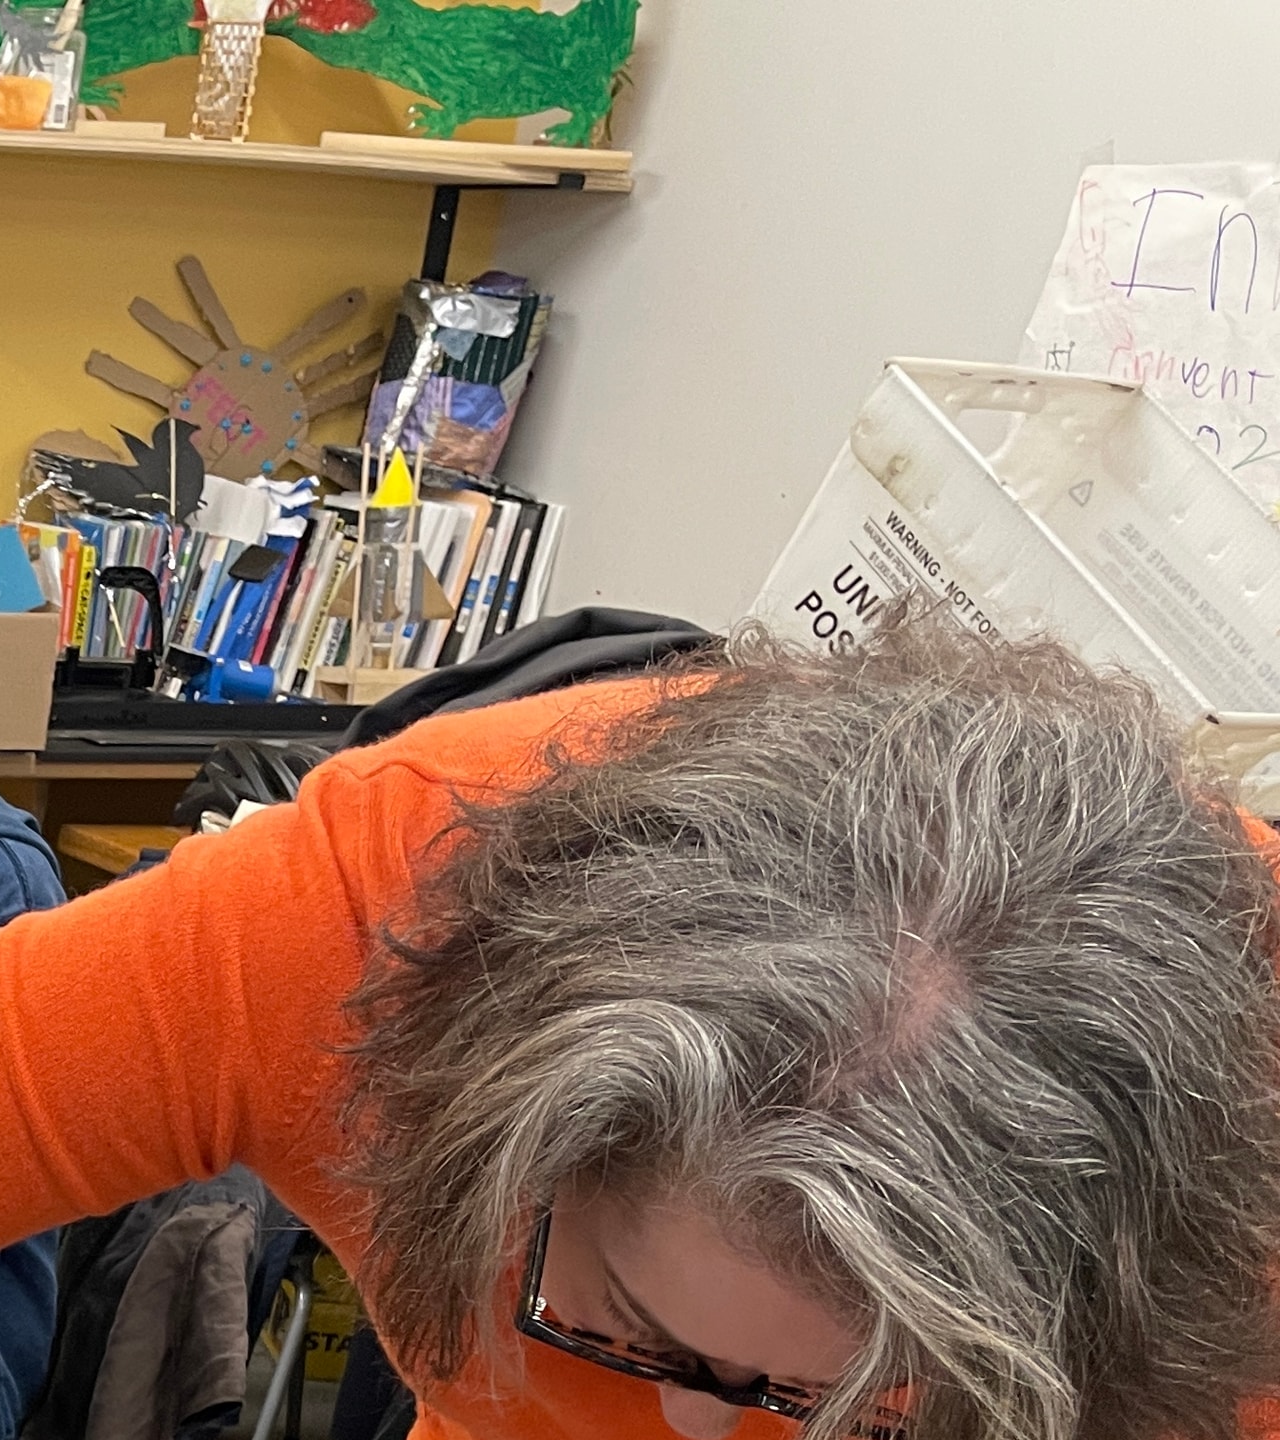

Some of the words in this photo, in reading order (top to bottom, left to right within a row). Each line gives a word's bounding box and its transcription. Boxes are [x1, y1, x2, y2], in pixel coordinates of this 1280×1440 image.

[1110, 187, 1280, 315] In
[833, 564, 885, 625] UNI
[886, 511, 941, 577] WARNING
[944, 581, 975, 613] NOT
[795, 590, 854, 655] POS
[304, 1332, 352, 1353] STA
